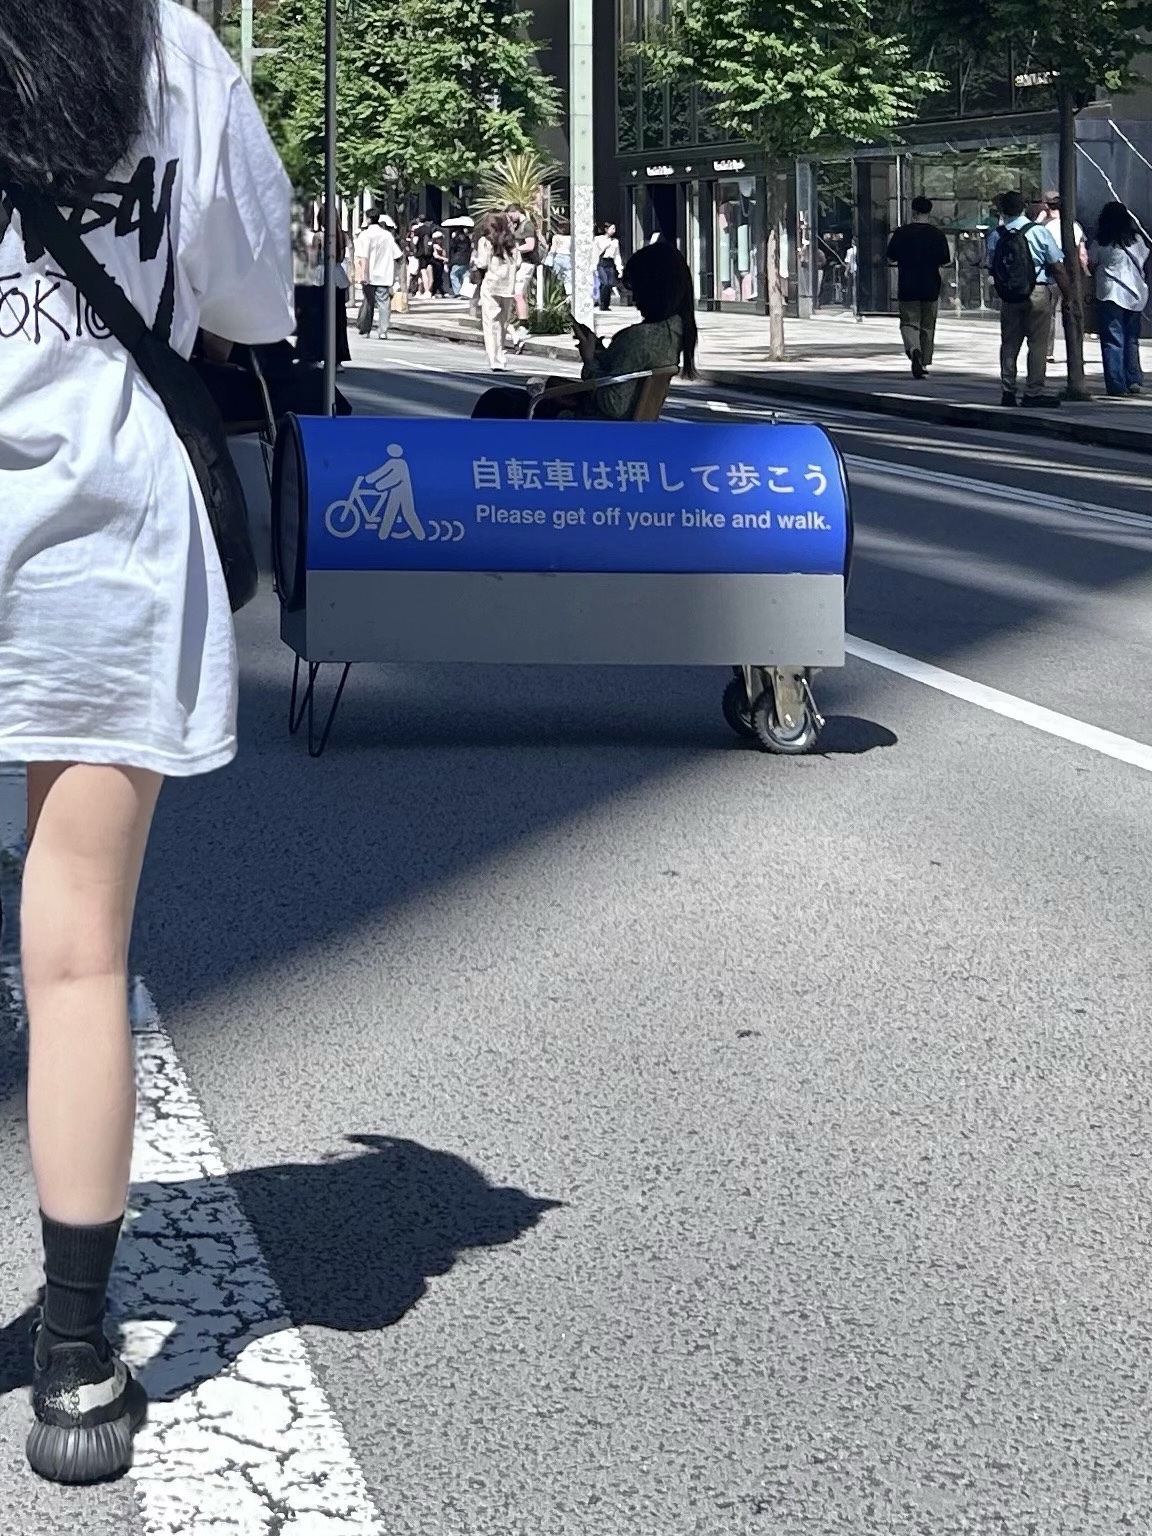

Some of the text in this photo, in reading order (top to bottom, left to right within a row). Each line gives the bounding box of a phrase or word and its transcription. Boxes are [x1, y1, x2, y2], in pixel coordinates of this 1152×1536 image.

[472, 456, 828, 497] 自転車は押して歩こう
[476, 504, 832, 531] Please get off your bike and walk.
